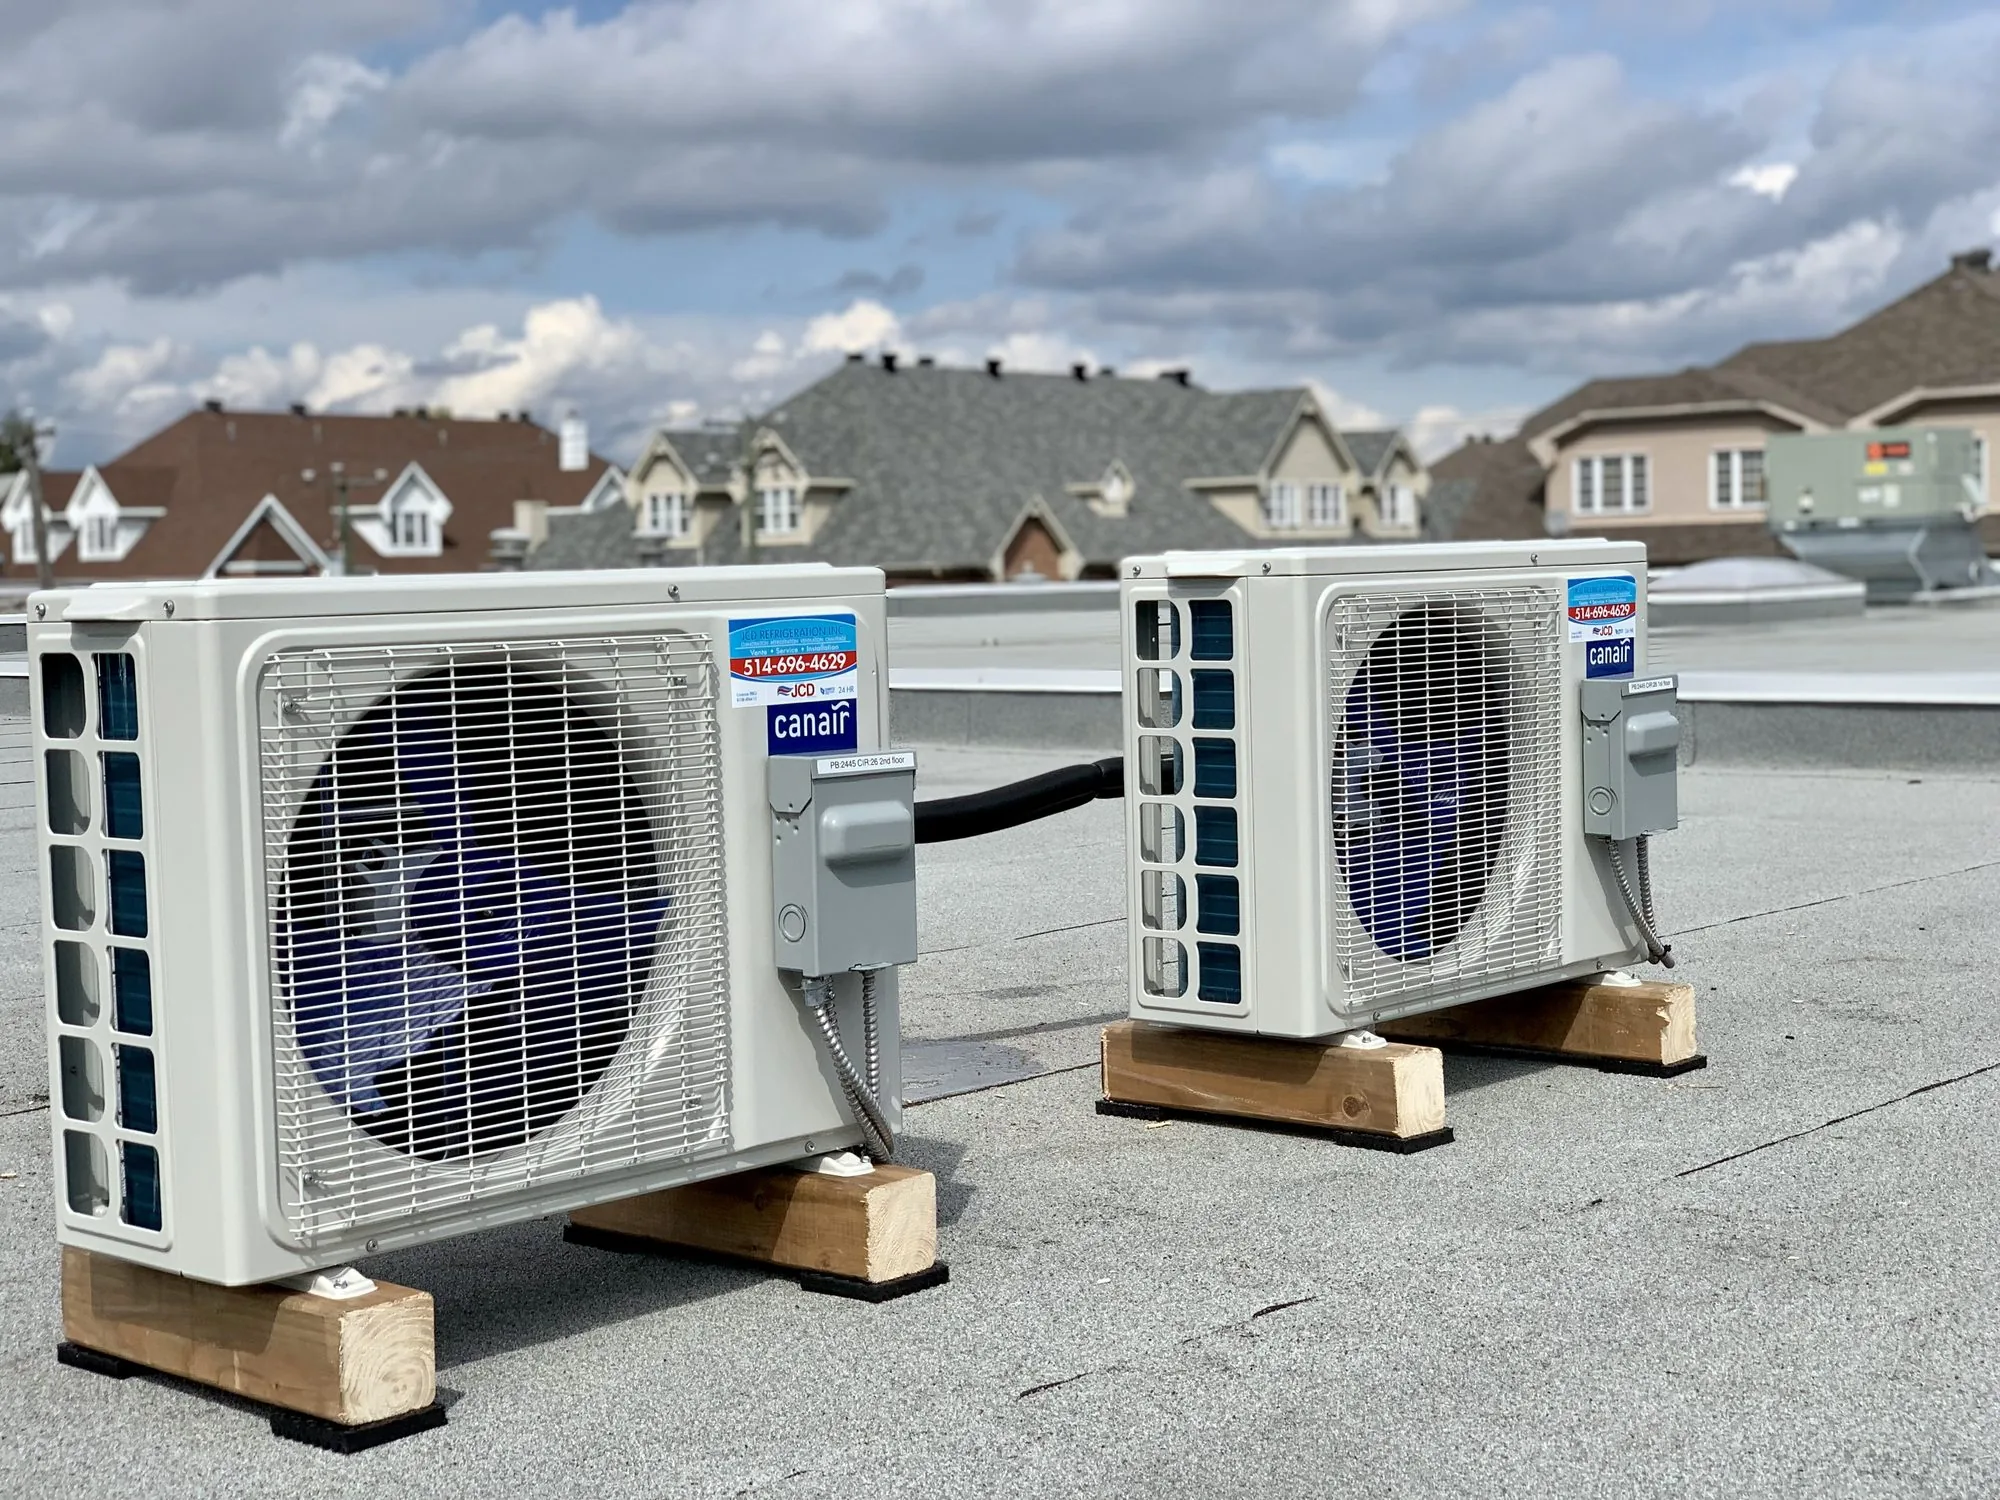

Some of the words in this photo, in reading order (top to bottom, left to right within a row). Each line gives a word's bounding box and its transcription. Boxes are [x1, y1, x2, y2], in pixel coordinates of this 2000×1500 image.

[1575, 604, 1631, 620] 514-696-4629
[759, 626, 826, 640] REFRIGERATION
[1600, 625, 1613, 636] JCD
[806, 644, 839, 653] Installation
[1589, 638, 1631, 665] canair
[743, 653, 847, 676] 514-696-4629
[791, 683, 815, 698] JCD
[774, 700, 850, 738] canair
[879, 757, 890, 765] 2nd
[891, 756, 905, 764] floor
